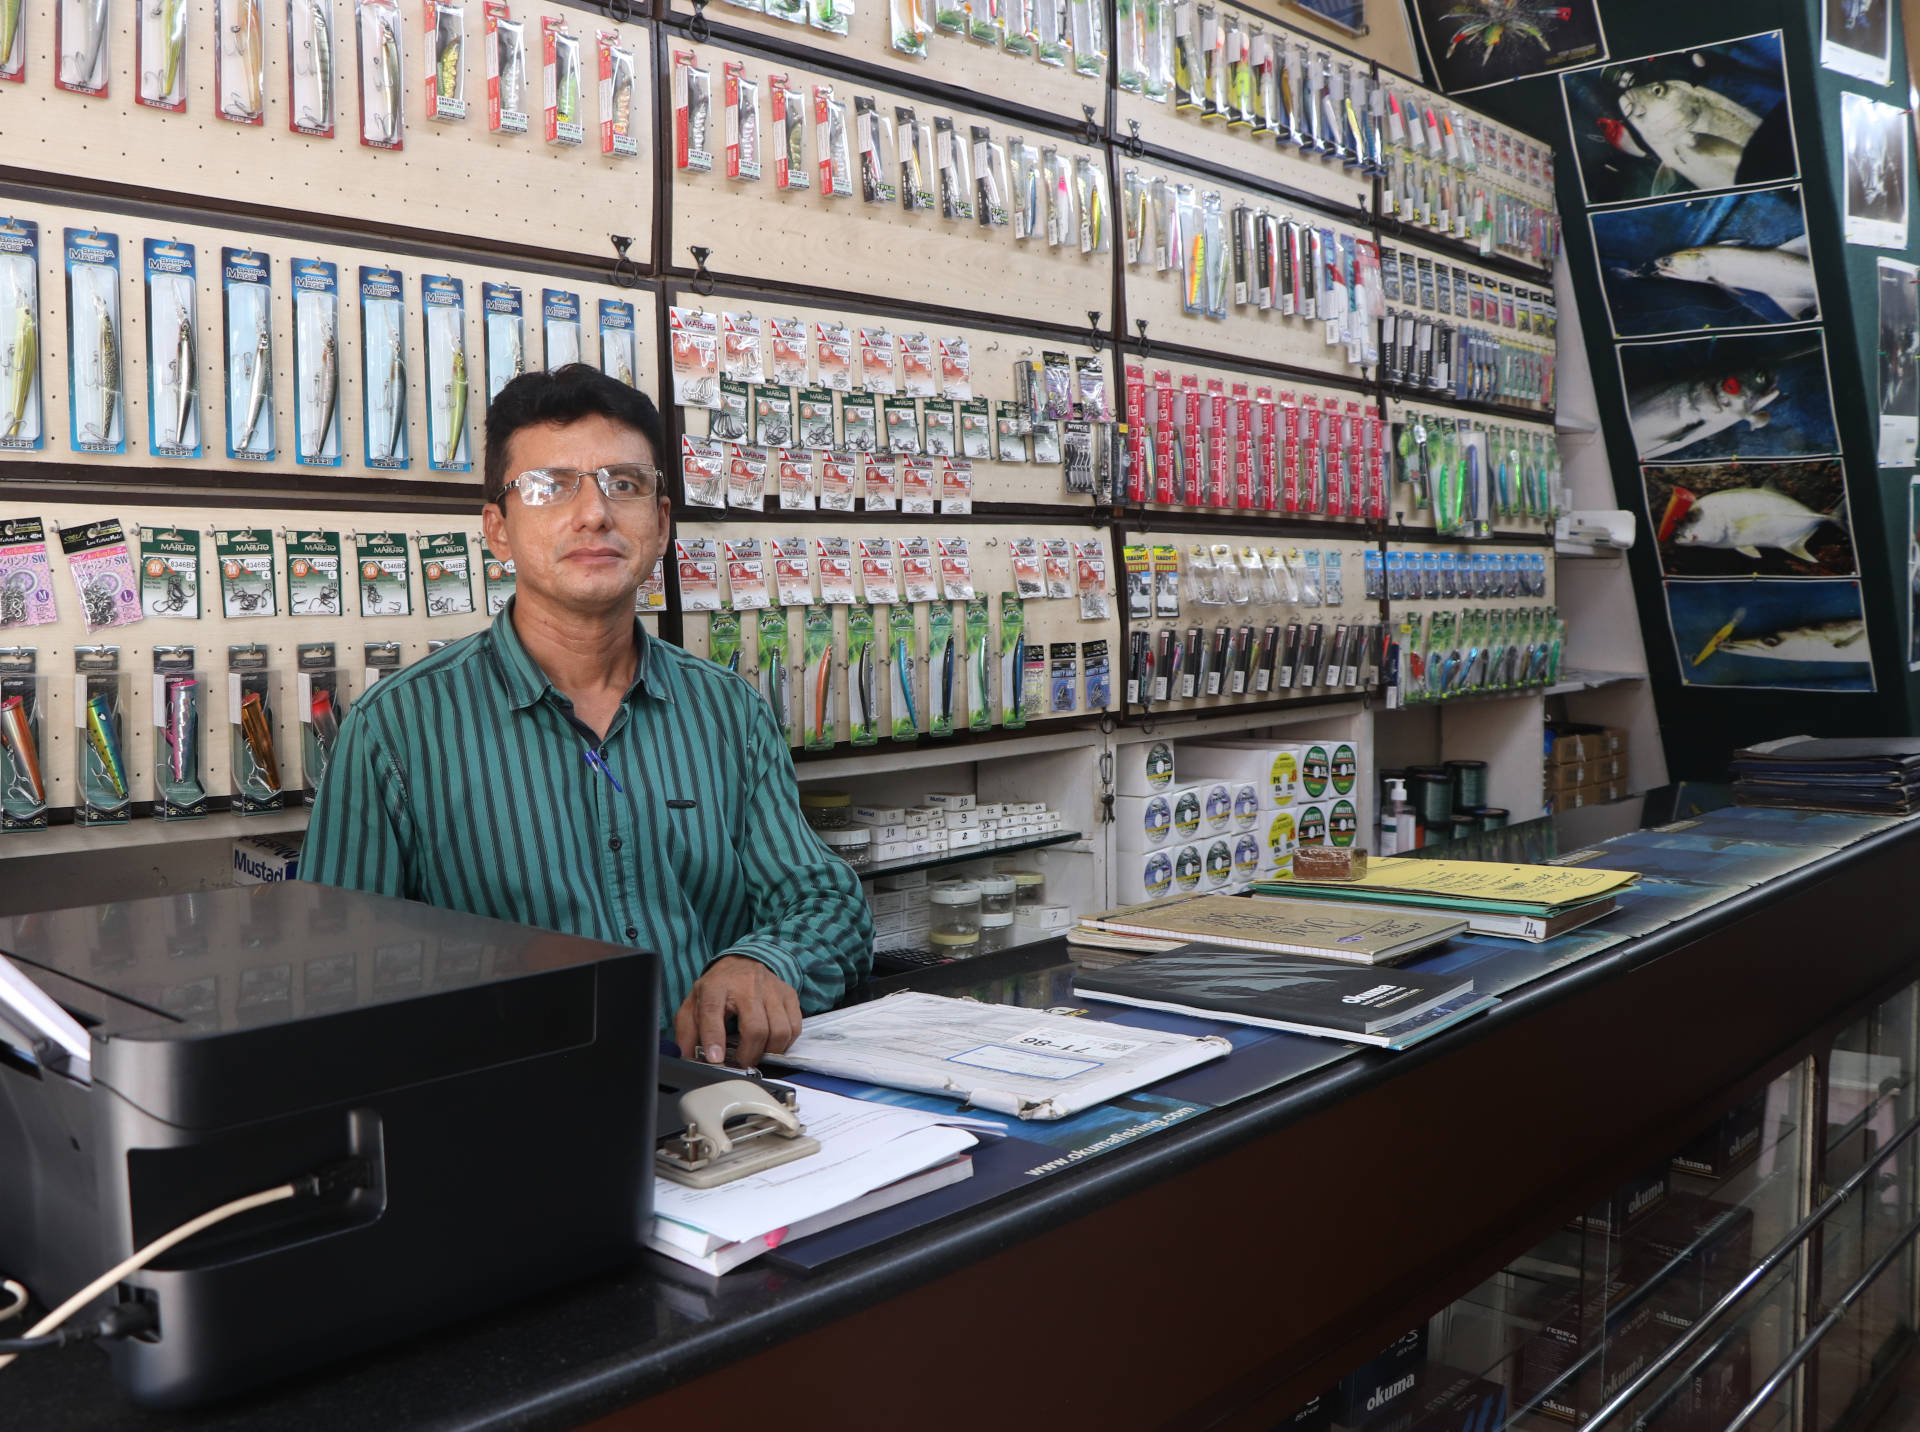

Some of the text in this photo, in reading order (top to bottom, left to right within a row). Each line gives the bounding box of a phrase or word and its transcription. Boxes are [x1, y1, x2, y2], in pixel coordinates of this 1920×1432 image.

[160, 544, 195, 552] MARUTO
[304, 544, 336, 552] MARUTO
[374, 545, 404, 553] MARUTO
[436, 545, 465, 554] MARUTO
[32, 554, 46, 563] SW
[114, 556, 128, 564] SW
[39, 592, 47, 600] M
[124, 591, 130, 600] L
[234, 848, 283, 882] Mustad
[1342, 984, 1398, 1004] okuma
[1024, 1106, 1197, 1176] www.okumafishing.com
[1672, 1156, 1712, 1171] okuma
[1628, 1180, 1664, 1214] okuma
[1366, 1372, 1416, 1412] okuma
